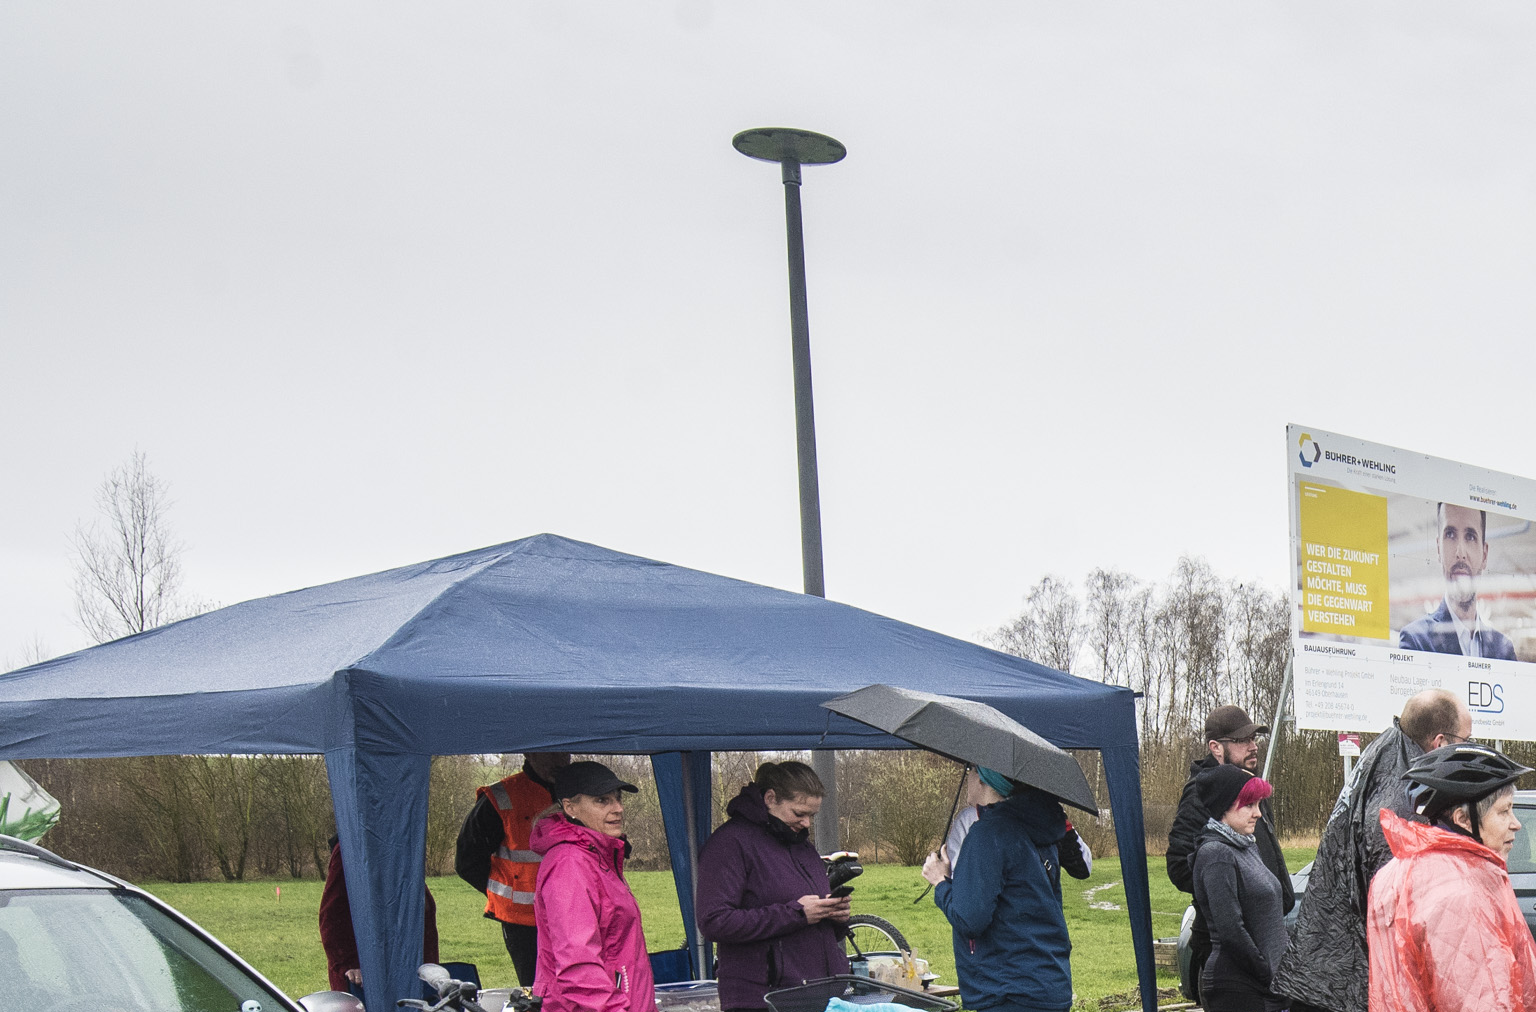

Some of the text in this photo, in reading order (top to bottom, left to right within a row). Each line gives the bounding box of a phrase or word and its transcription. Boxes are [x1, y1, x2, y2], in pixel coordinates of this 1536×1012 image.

[1306, 543, 1379, 565] WER DIE ZUKUNFT
[1306, 560, 1352, 577] GESTALTEN
[1307, 575, 1367, 596] MÖCHTE, MUSS
[1307, 593, 1373, 613] DIE GEGENWART
[1308, 609, 1355, 627] VERSTEHEN
[1304, 644, 1356, 657] BAUAUSFÜHRUNG
[1389, 653, 1414, 662] PROJEKT
[1467, 661, 1491, 670] BAUHERR
[1390, 674, 1411, 685] Neubau
[1431, 678, 1442, 687] und
[1468, 681, 1504, 713] EDS
